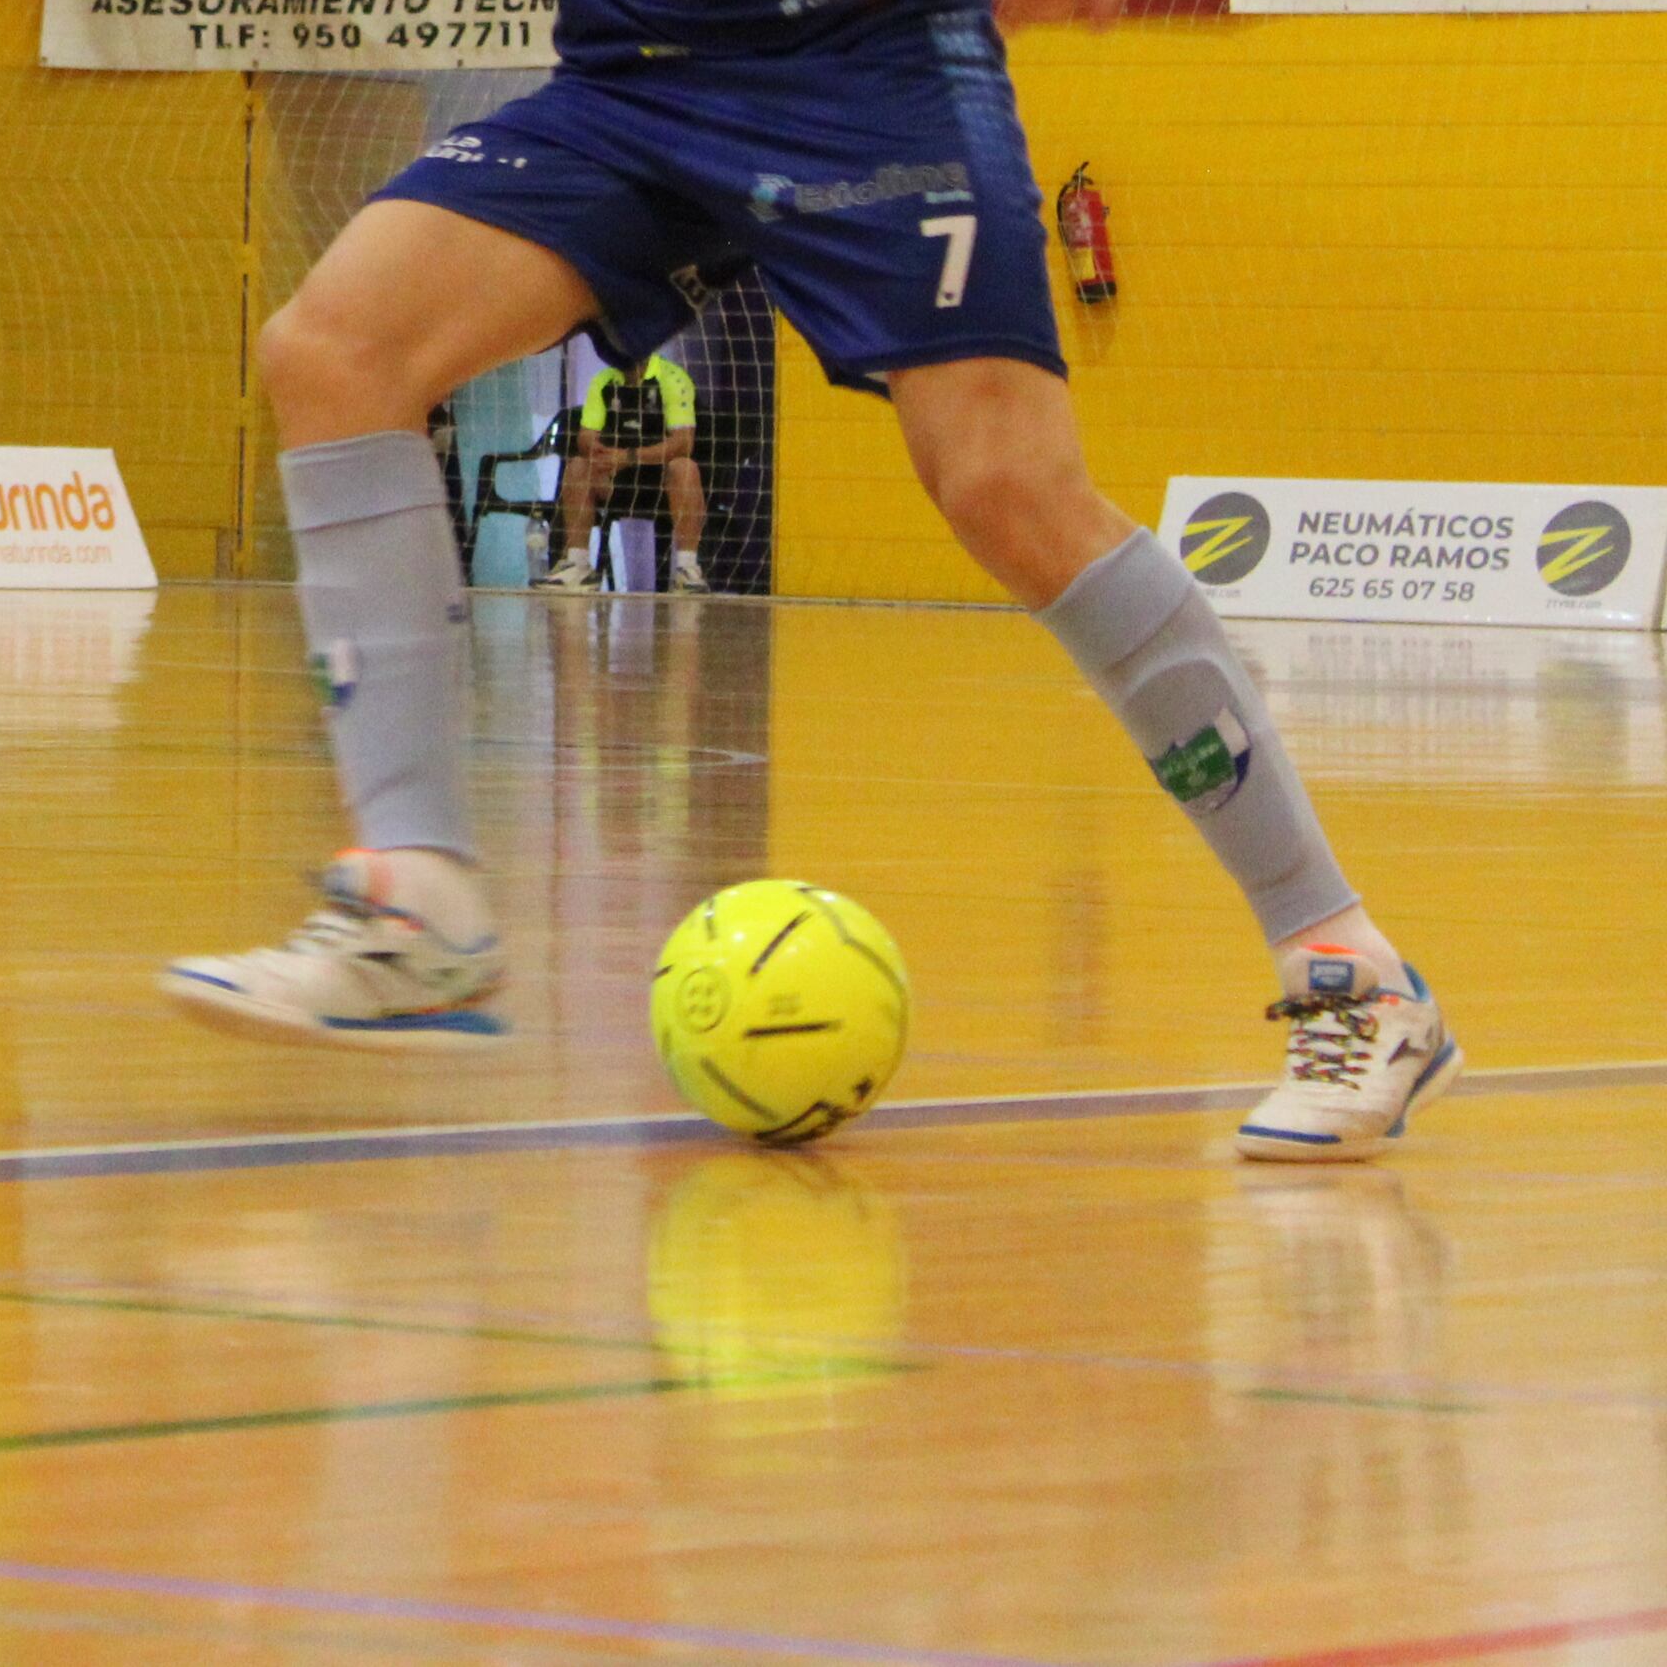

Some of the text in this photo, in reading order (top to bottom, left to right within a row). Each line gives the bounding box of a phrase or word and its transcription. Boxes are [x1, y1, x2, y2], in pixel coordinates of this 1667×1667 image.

[189, 20, 532, 50] TLF: 950 497711
[919, 214, 978, 309] 7
[1296, 505, 1515, 540] NEUMÁTICOS
[1288, 541, 1510, 571] PACO RAMOS
[1308, 577, 1475, 603] 625 65 07 58
